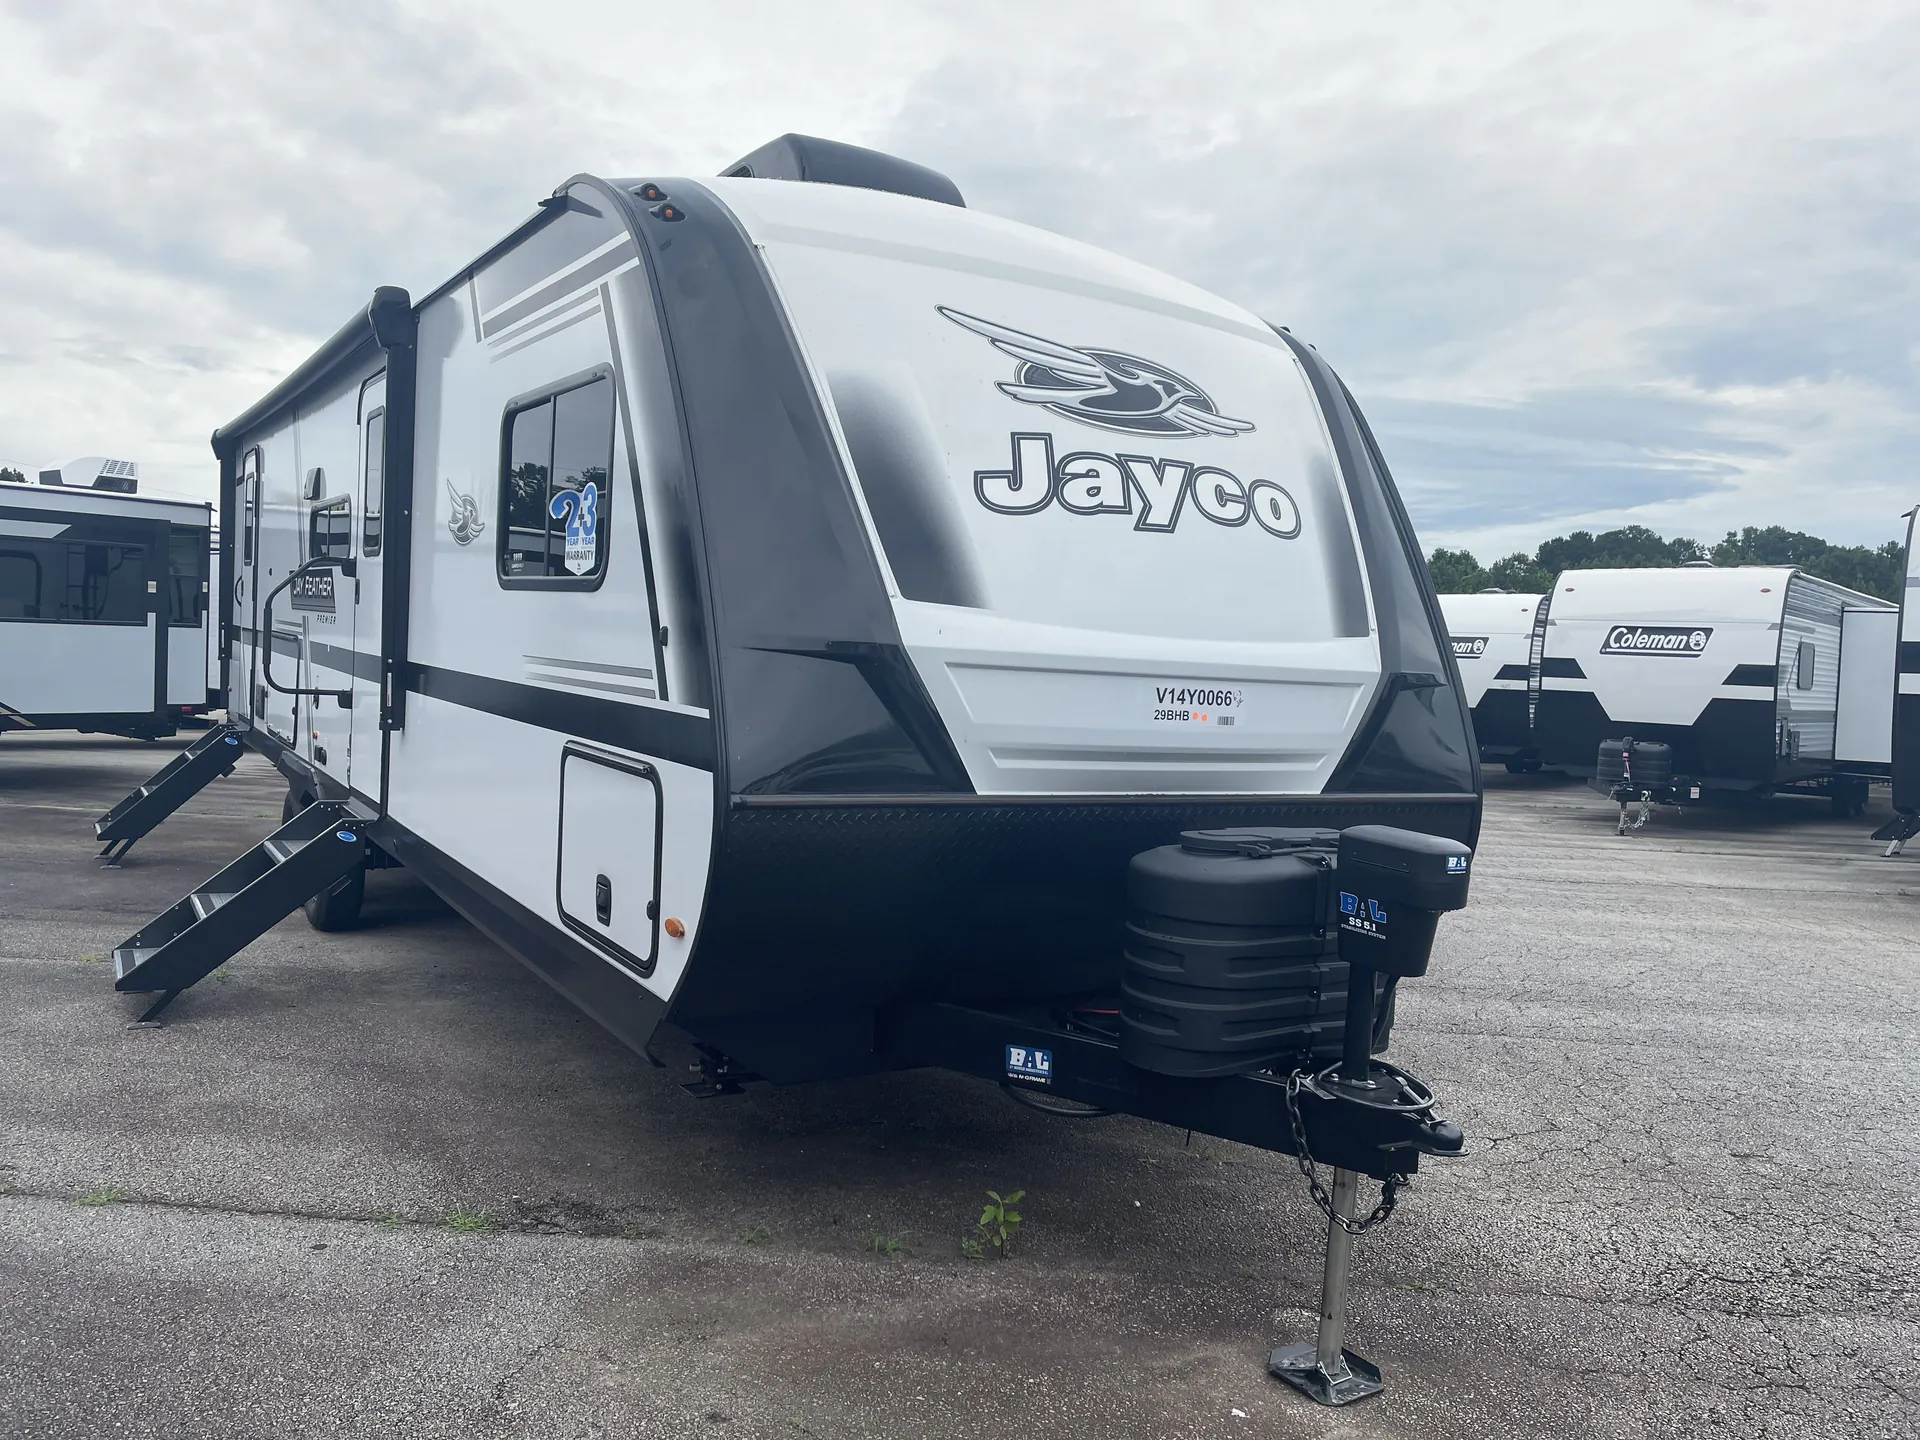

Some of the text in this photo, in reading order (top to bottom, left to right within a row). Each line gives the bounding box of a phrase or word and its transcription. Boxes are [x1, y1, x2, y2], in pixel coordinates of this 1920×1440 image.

[973, 431, 1302, 540] Jayco
[567, 536, 595, 546] YEAR YEAR
[566, 550, 594, 561] WARRANTY
[293, 575, 332, 596] JAY FEATHER
[316, 614, 337, 624] PREMIER
[1609, 627, 1688, 649] Coleman
[1154, 709, 1190, 721] 29BHB
[1340, 891, 1387, 924] BAL
[1348, 916, 1362, 927] SS
[1009, 1047, 1049, 1071] BAL
